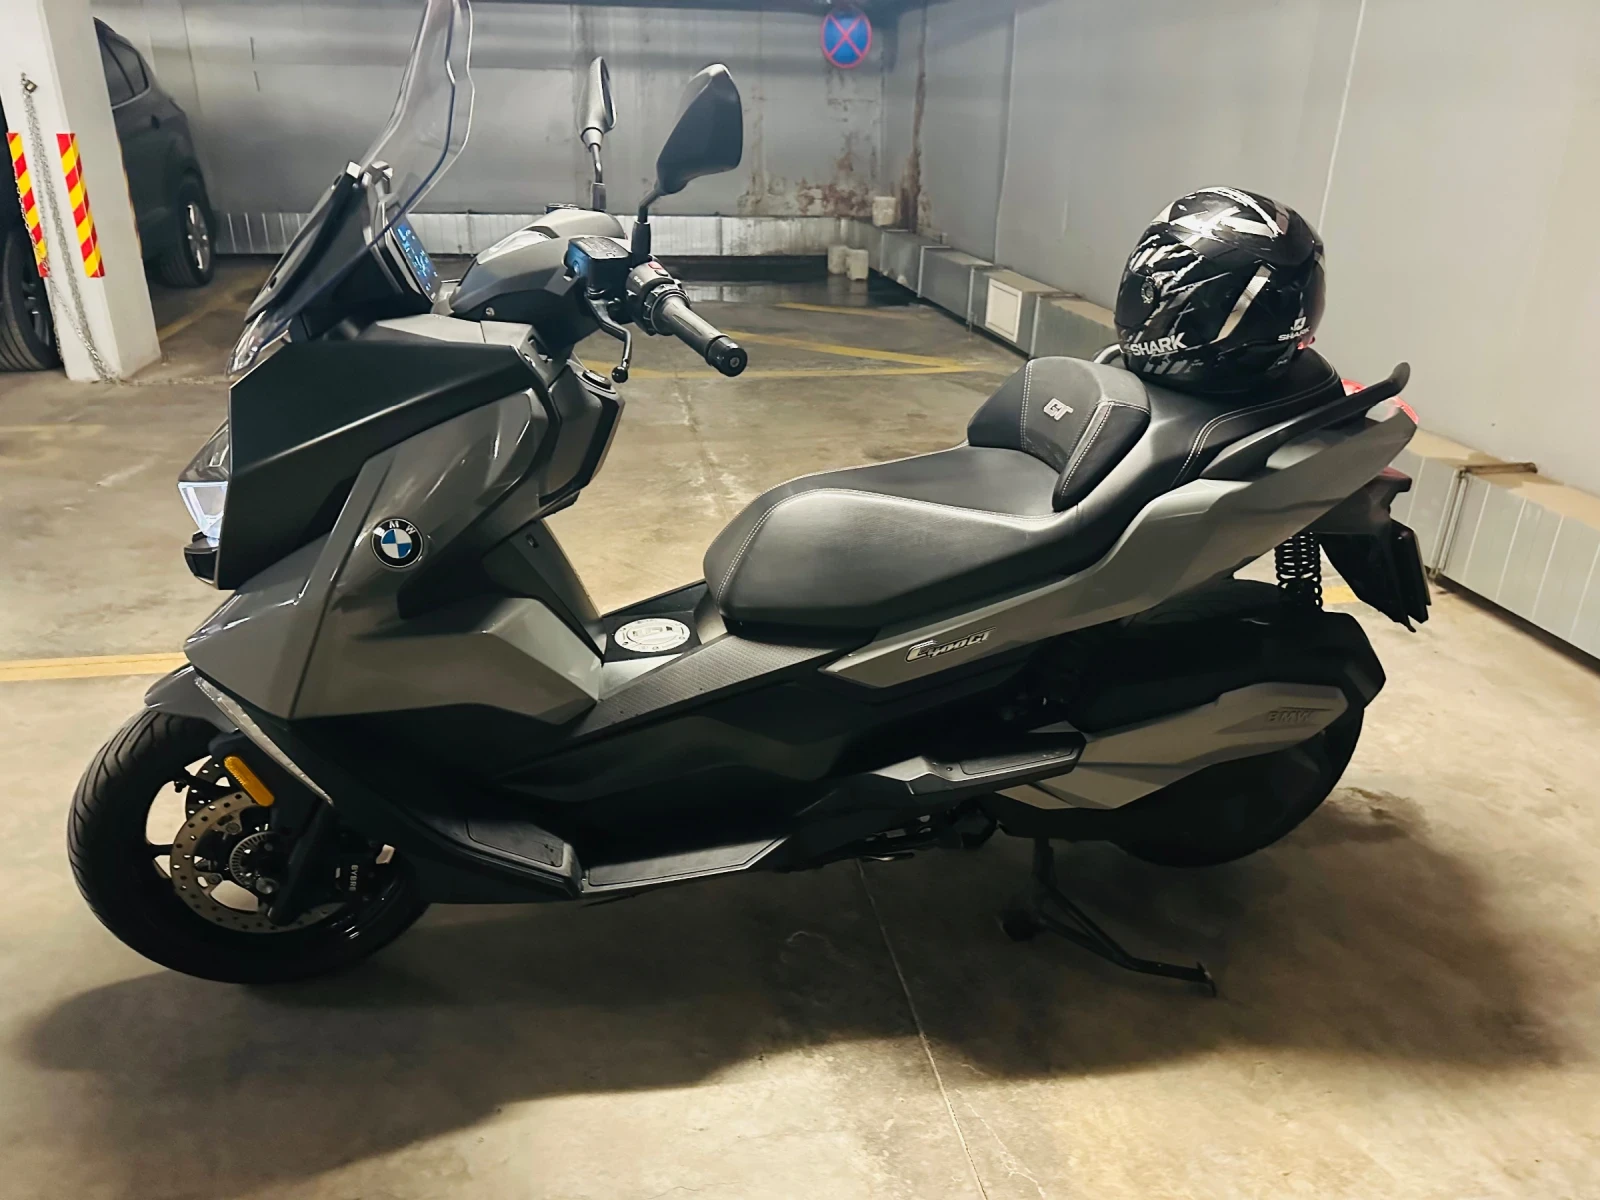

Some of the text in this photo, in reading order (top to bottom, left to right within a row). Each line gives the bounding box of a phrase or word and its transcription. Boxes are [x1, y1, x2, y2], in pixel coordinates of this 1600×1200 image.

[1278, 326, 1310, 341] SHARK
[1130, 332, 1187, 356] SHARK
[1043, 398, 1074, 420] GT
[373, 521, 416, 537] BMW
[1268, 711, 1314, 722] BMW
